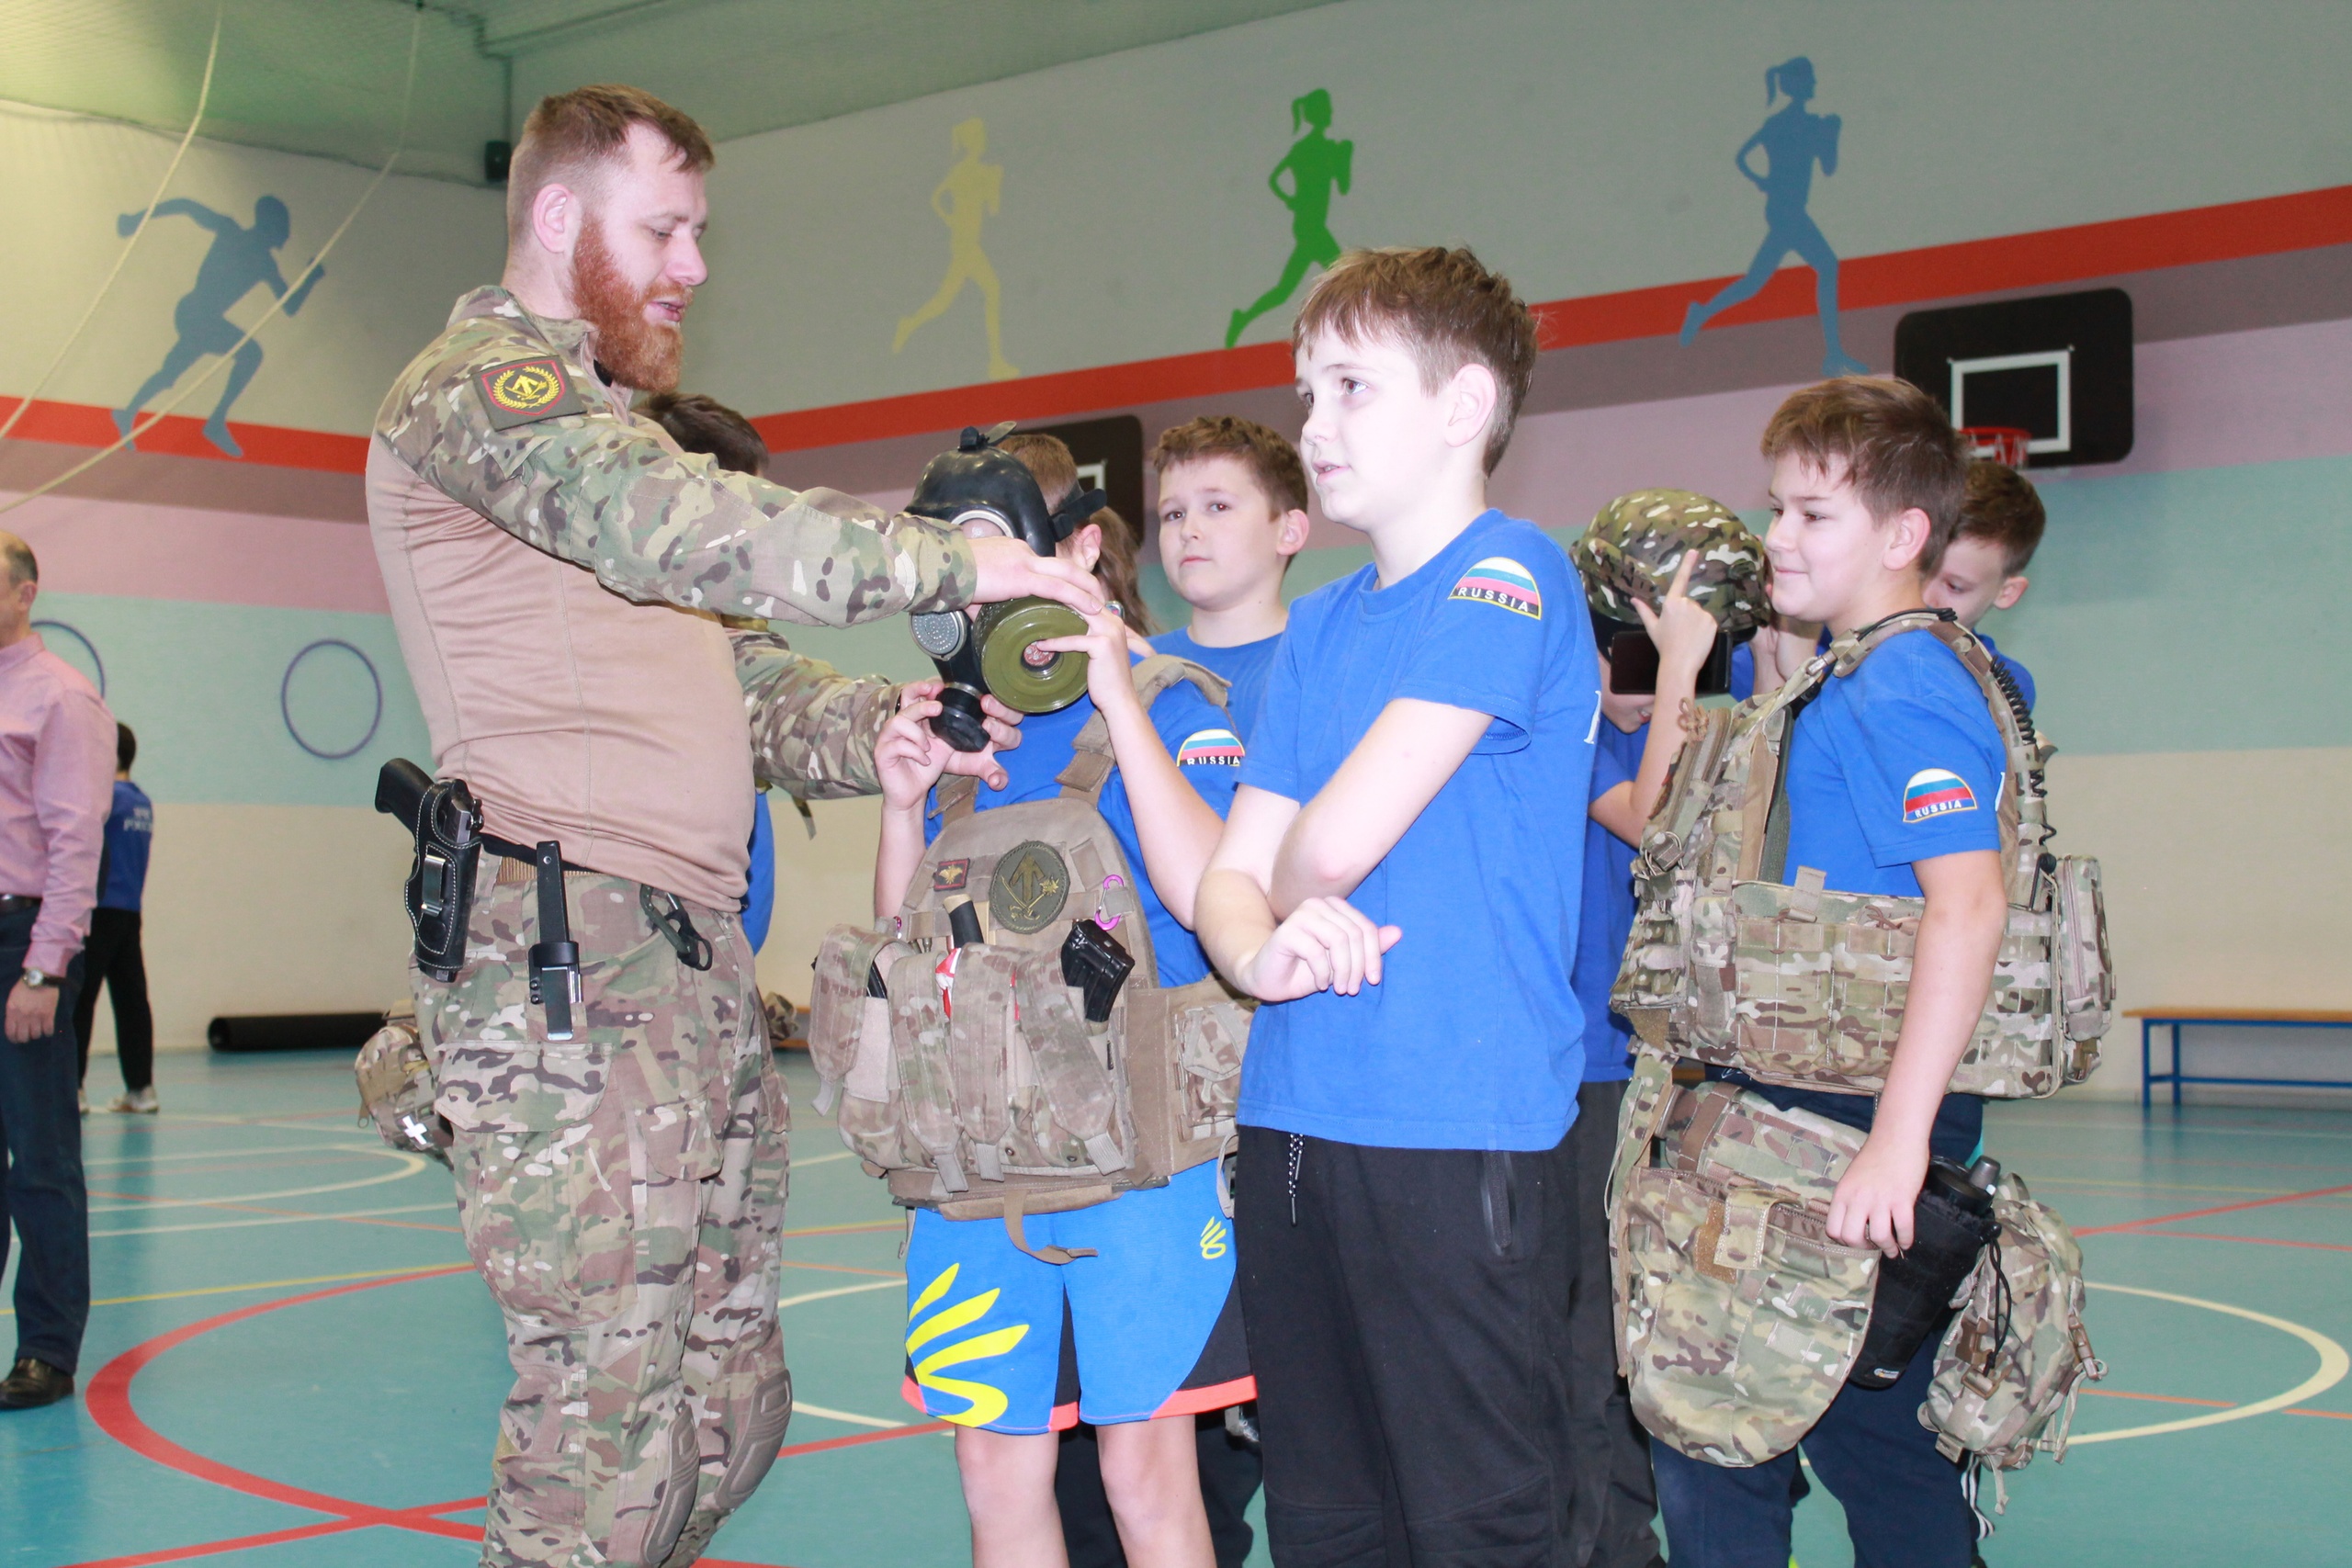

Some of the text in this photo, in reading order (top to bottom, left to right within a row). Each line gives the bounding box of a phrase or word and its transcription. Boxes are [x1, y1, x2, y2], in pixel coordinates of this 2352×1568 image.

[1457, 587, 1529, 613] RUSSIA
[1186, 755, 1240, 766] RUSSIA
[1914, 799, 1962, 818] RUSSIA
